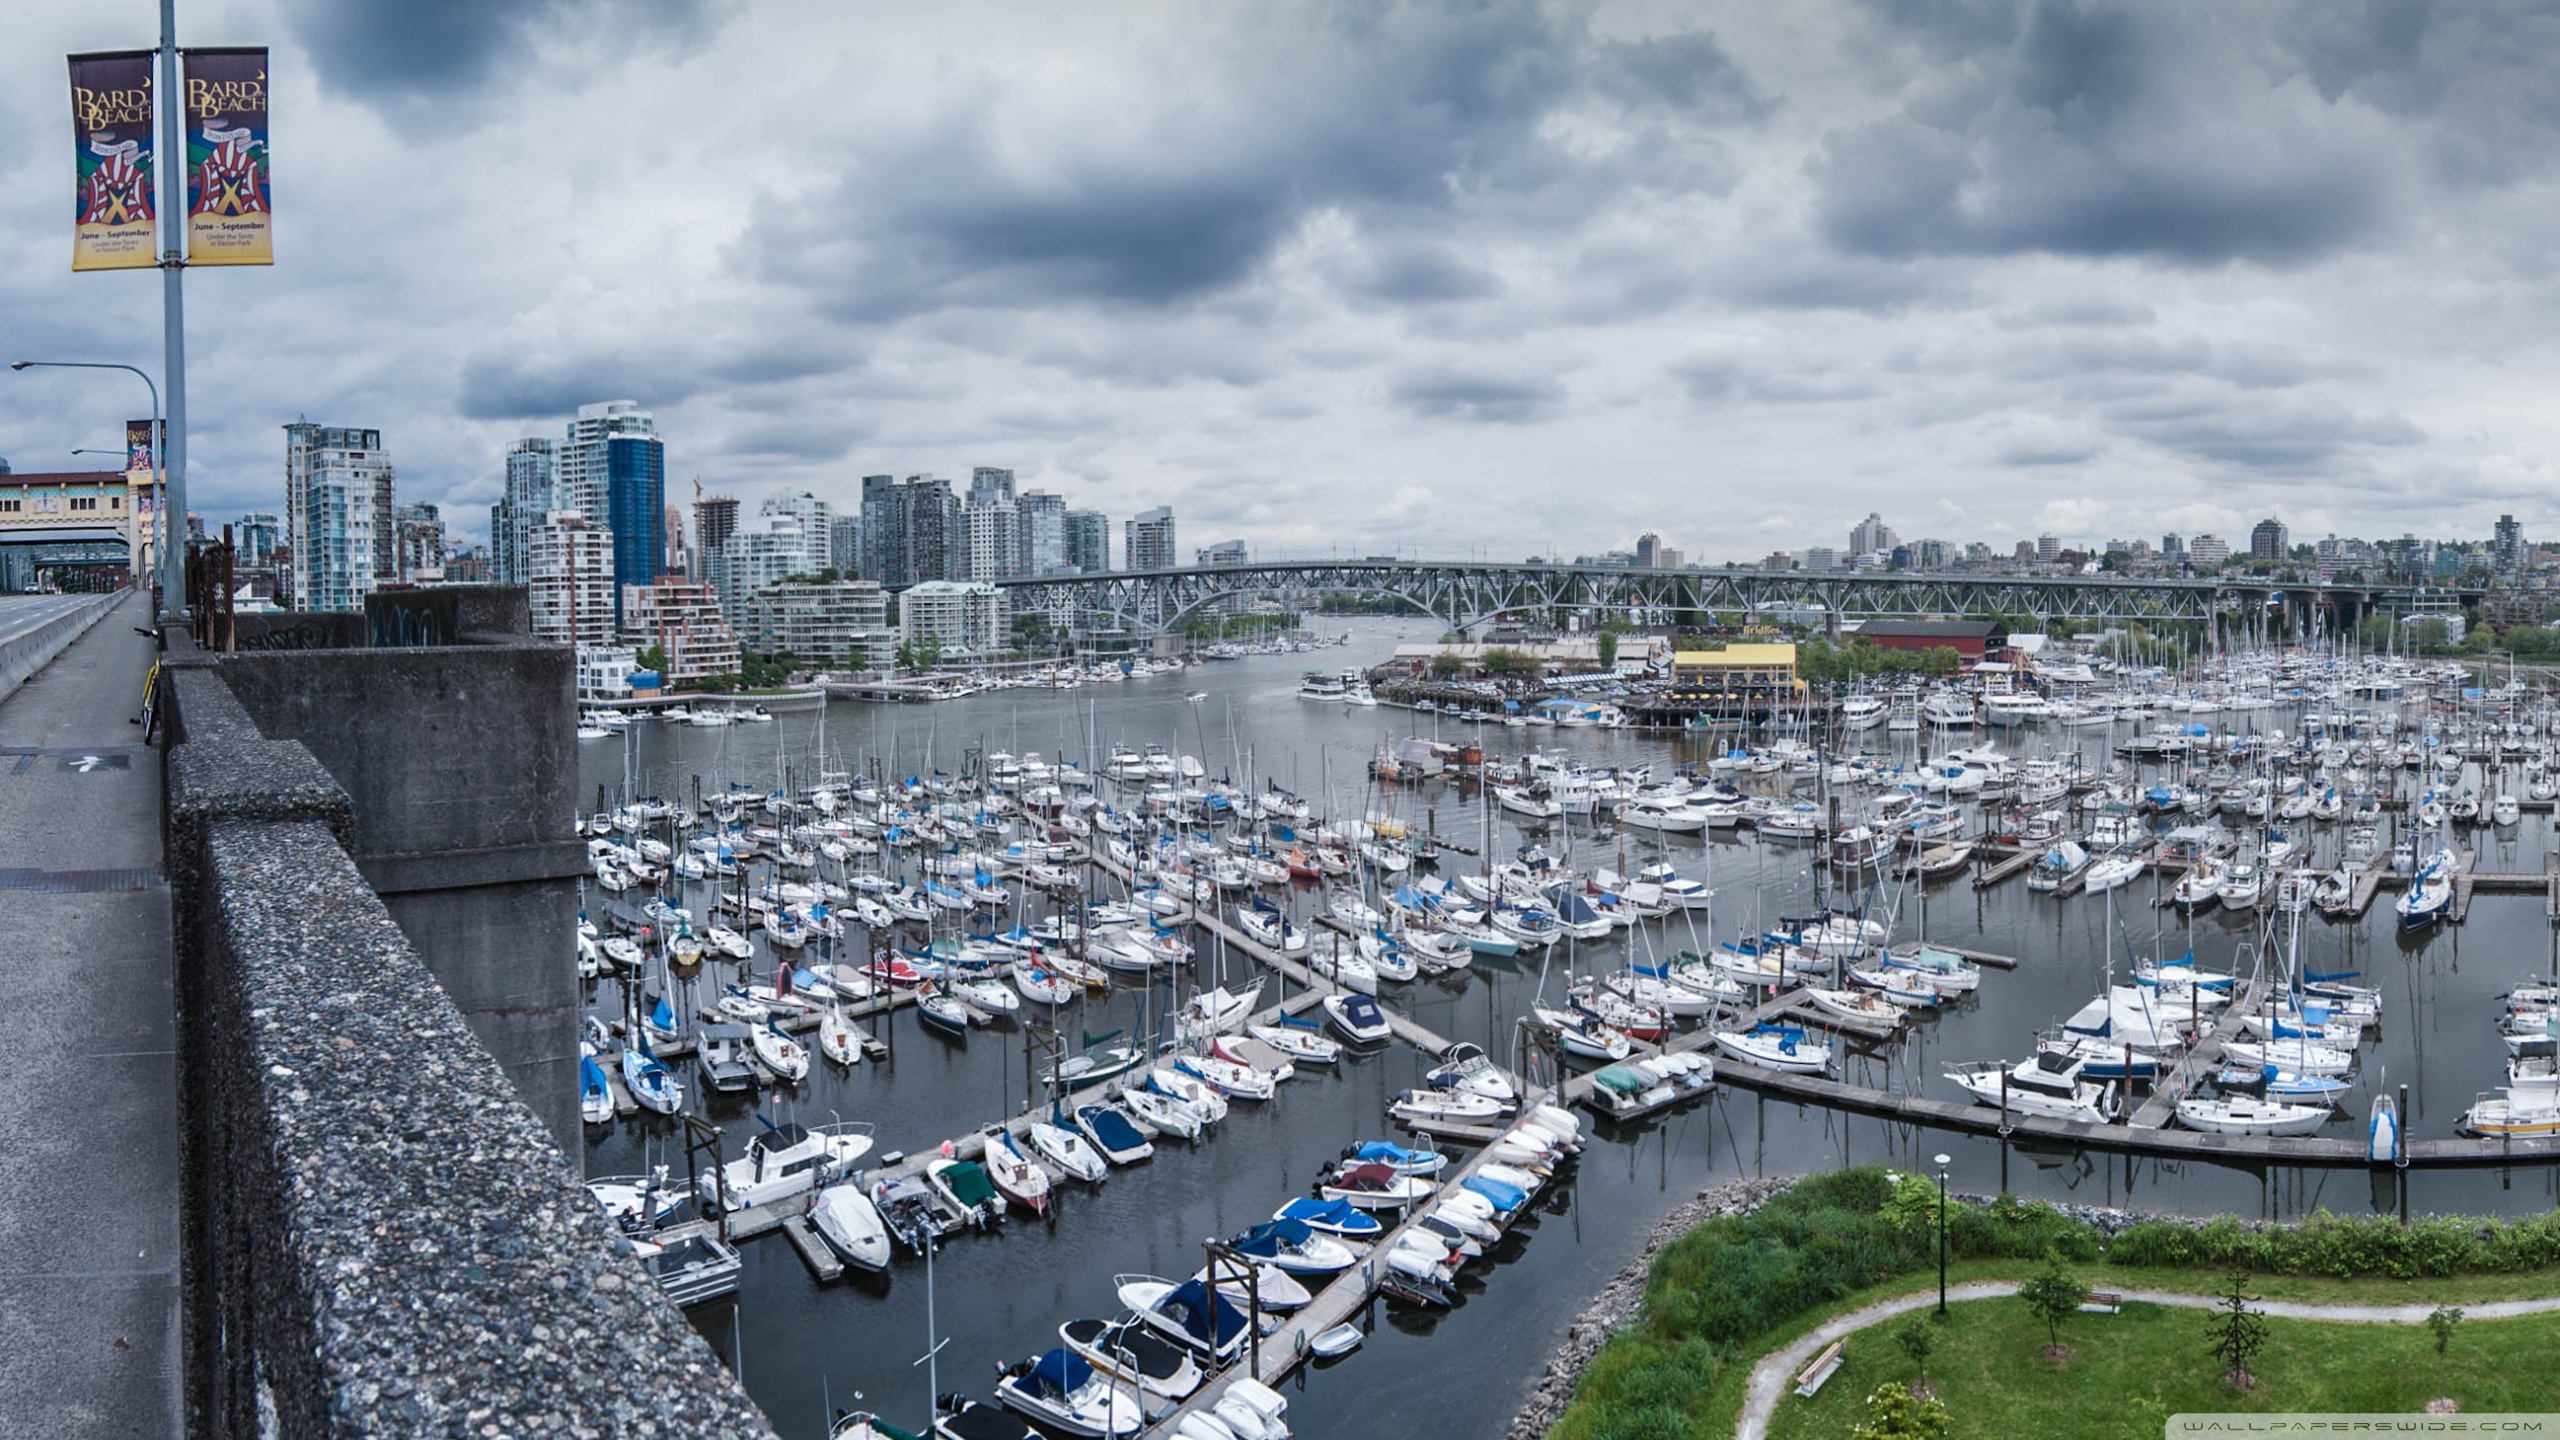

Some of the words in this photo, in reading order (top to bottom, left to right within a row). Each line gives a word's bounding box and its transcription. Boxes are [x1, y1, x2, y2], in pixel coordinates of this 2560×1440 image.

[73, 87, 146, 120] BARD
[187, 79, 261, 108] BARD
[88, 105, 151, 131] BEACH
[200, 96, 266, 118] BEACH
[107, 229, 150, 239] September
[194, 223, 214, 231] June
[221, 222, 265, 231] September
